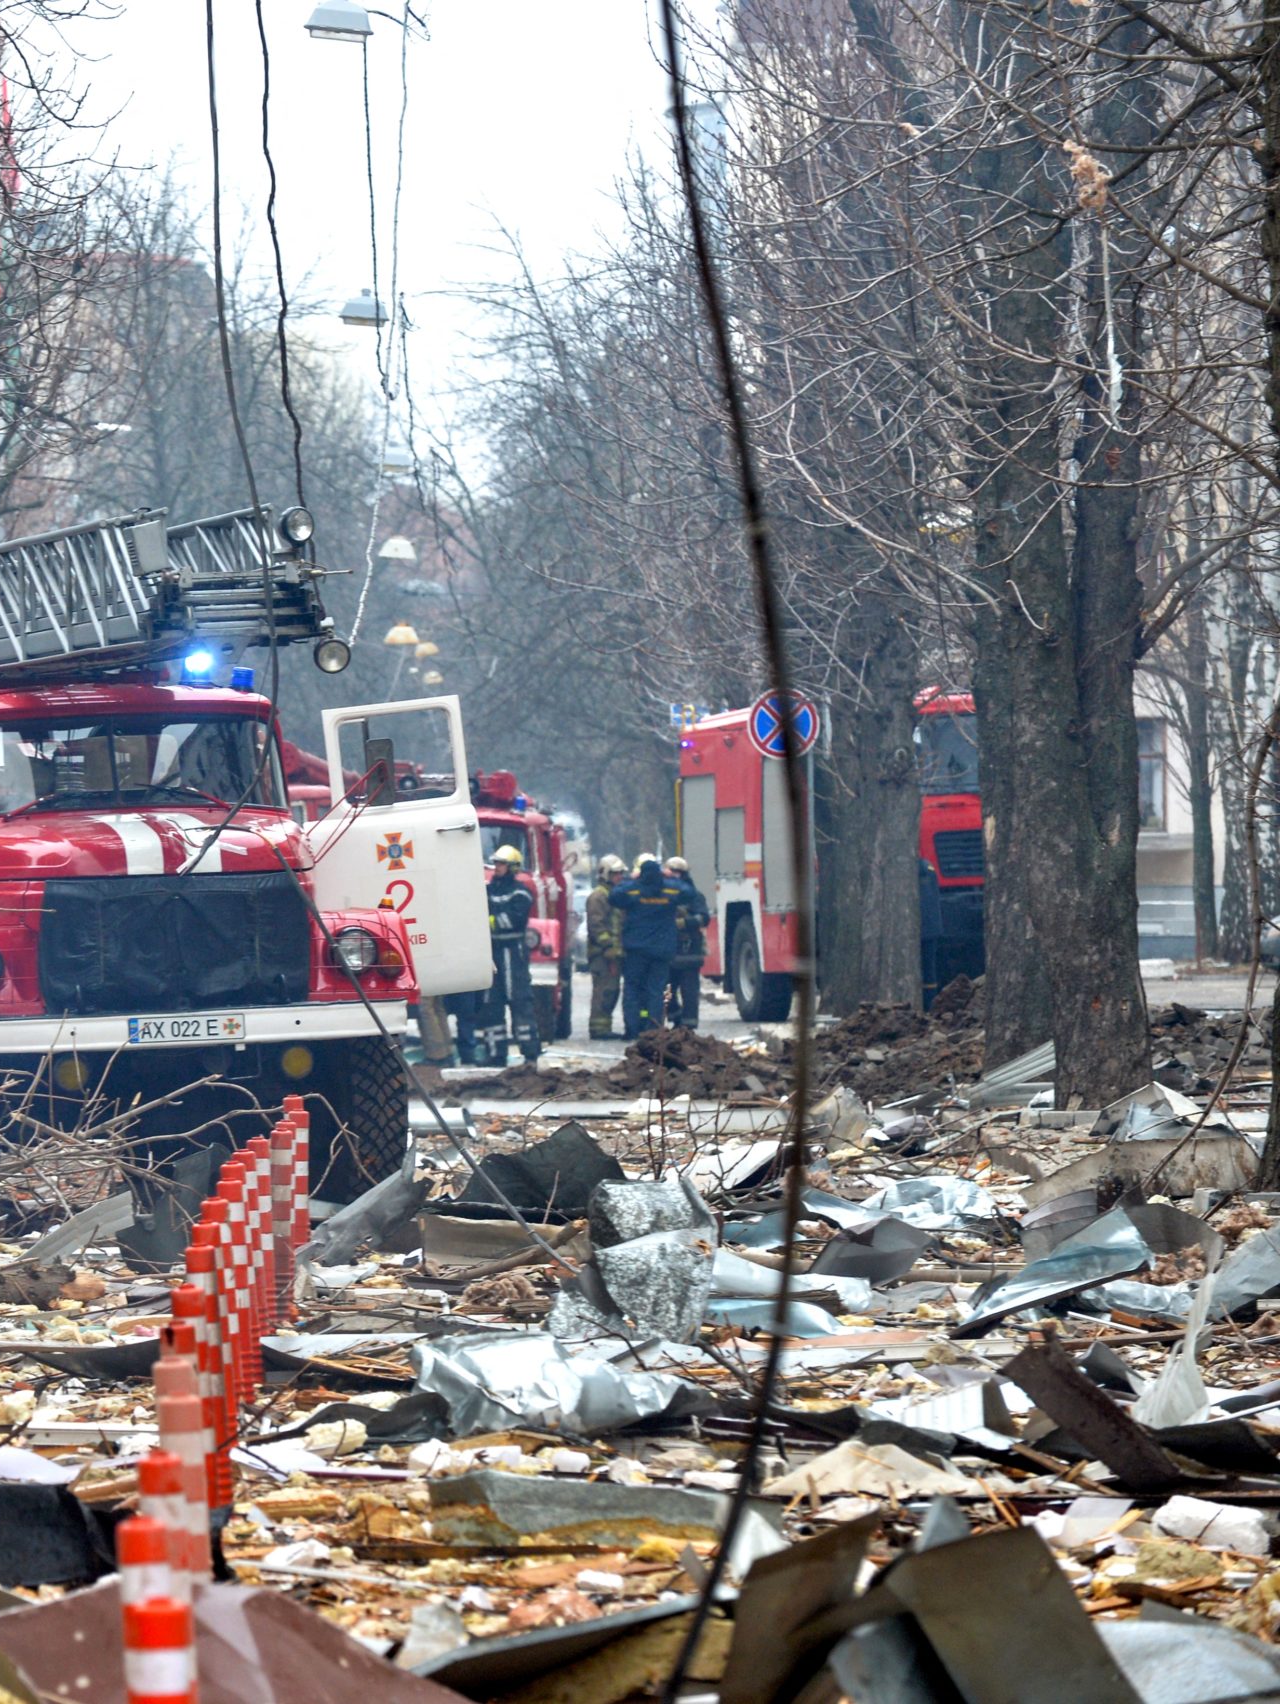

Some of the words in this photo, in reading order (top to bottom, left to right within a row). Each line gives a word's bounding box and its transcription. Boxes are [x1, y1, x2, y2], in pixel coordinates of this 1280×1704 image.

[386, 880, 416, 924] 2
[408, 934, 427, 945] КІВ
[141, 1022, 165, 1039] AX
[171, 1020, 200, 1037] 022
[207, 1019, 219, 1035] E
